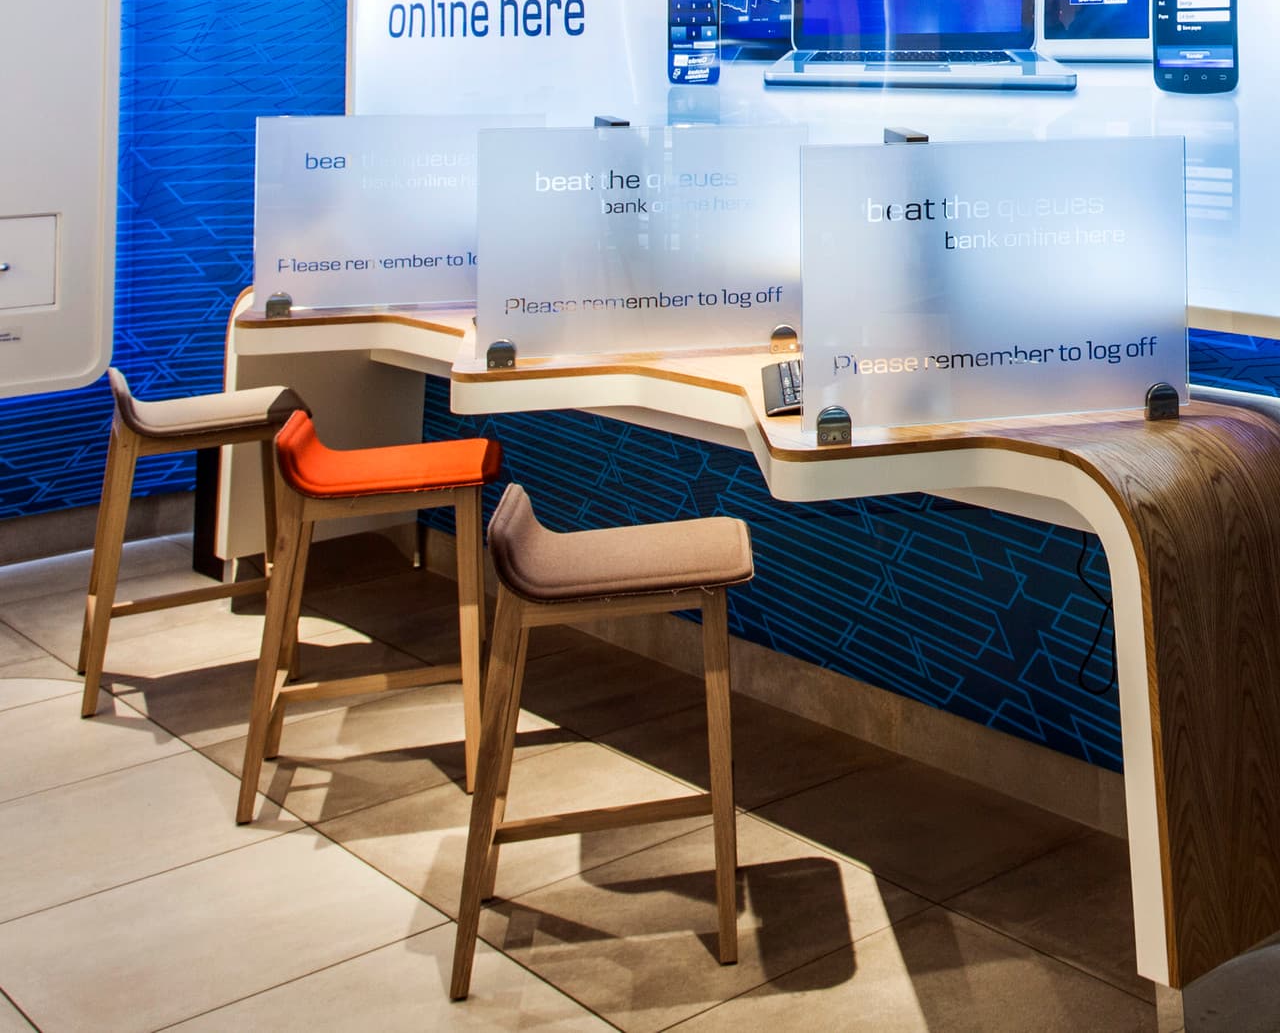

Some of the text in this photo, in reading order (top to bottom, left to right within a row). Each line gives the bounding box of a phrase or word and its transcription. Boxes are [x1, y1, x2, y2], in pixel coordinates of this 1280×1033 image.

[305, 152, 352, 170] bea
[535, 169, 738, 193] beat the qeues
[602, 197, 648, 214] bank
[866, 197, 936, 223] beat
[942, 195, 990, 220] the
[944, 223, 1128, 250] bank online here
[446, 254, 464, 267] to
[505, 286, 783, 315] Please remember to log off
[833, 336, 1157, 375] Please remember to log off
